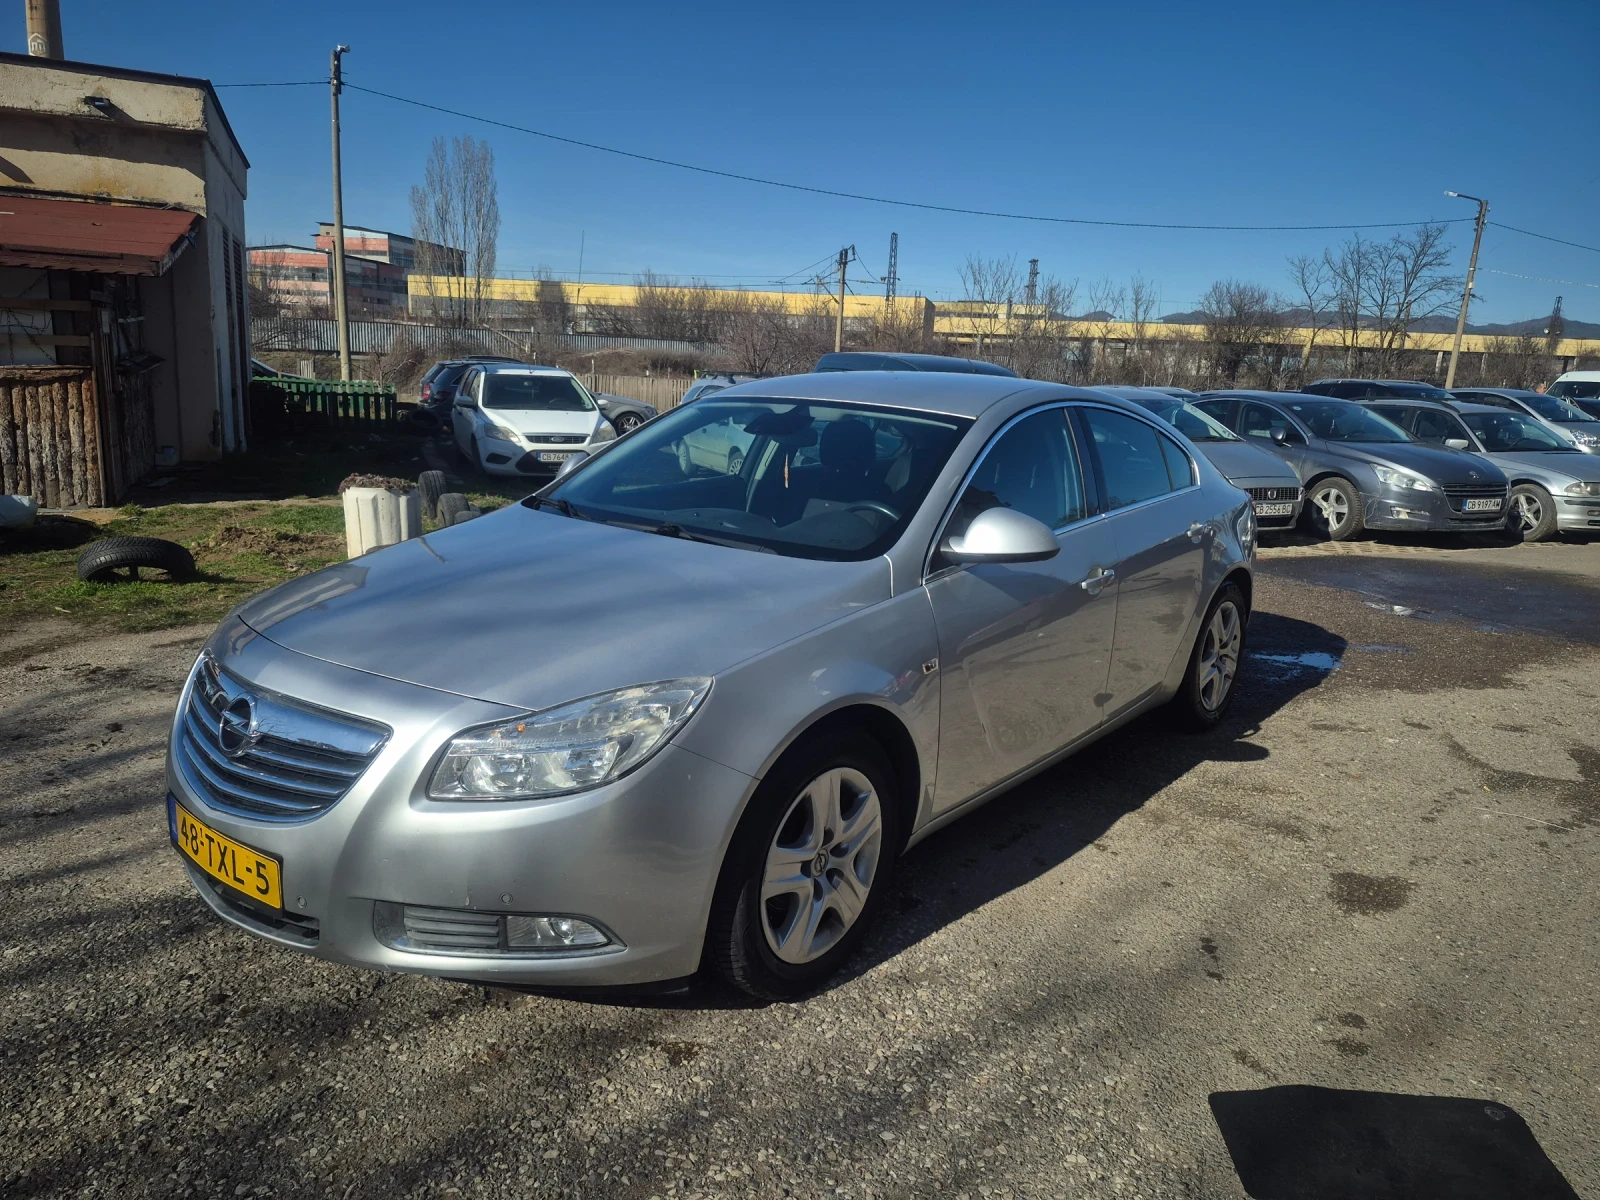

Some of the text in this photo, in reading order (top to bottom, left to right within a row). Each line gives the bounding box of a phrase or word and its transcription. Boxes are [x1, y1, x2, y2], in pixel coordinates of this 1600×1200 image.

[542, 453, 551, 461] CB
[1468, 500, 1476, 509] CB
[1477, 499, 1492, 509] 9197
[181, 816, 270, 895] 48-TXL-5
